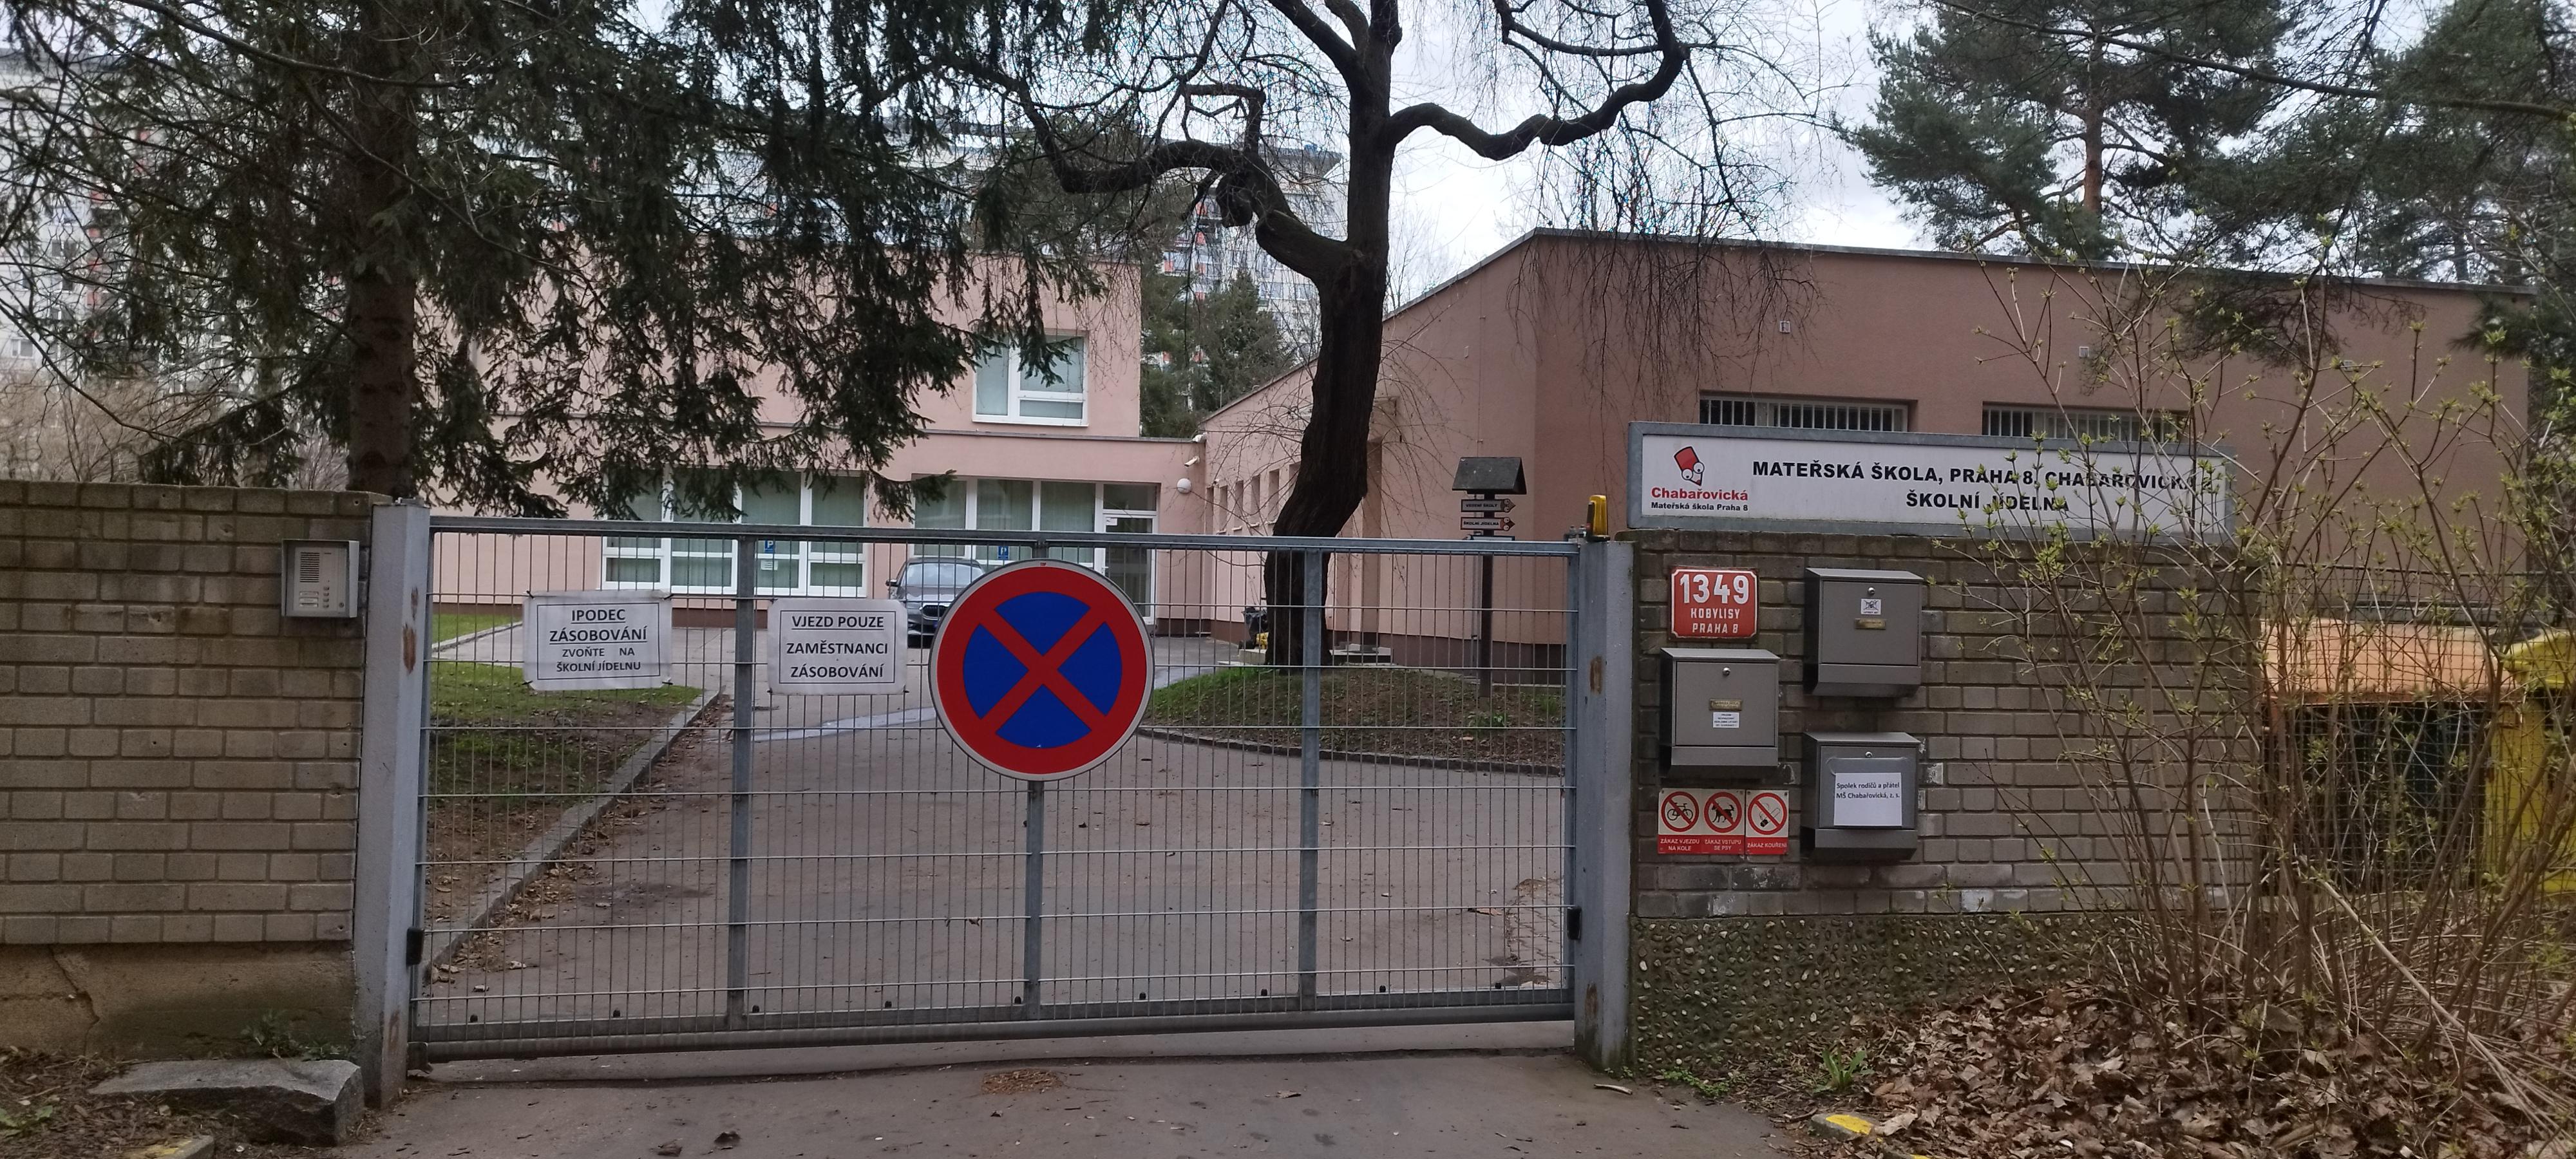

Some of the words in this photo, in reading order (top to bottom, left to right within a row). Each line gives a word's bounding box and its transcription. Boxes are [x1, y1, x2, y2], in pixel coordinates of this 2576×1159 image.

[1752, 460, 1864, 479] MATEŘSKÁ
[1871, 462, 1943, 485] ŠKOLA,
[1950, 467, 2018, 484] PRAHA
[1651, 487, 1748, 501] Chabařovická
[1906, 489, 1980, 509] ŠKOLNÍ
[1680, 574, 1749, 605] 1349
[571, 609, 626, 621] IPODEC
[1690, 608, 1740, 619] KOBYLISY
[792, 616, 834, 627] VJEZD
[838, 616, 884, 628] POUZE
[1692, 623, 1728, 634] PRAHA
[1732, 623, 1739, 634] 8
[549, 625, 648, 642] ZÁSOBOVÁNÍ
[562, 646, 605, 657] ZVOŇTE
[619, 647, 635, 656] NA
[786, 640, 888, 654] ZAMĚSTNANCI
[556, 661, 595, 672] ŠKOLNÍ
[597, 660, 641, 671] JÍDELNU
[790, 663, 885, 678] ZÁSOBOVÁNÍ
